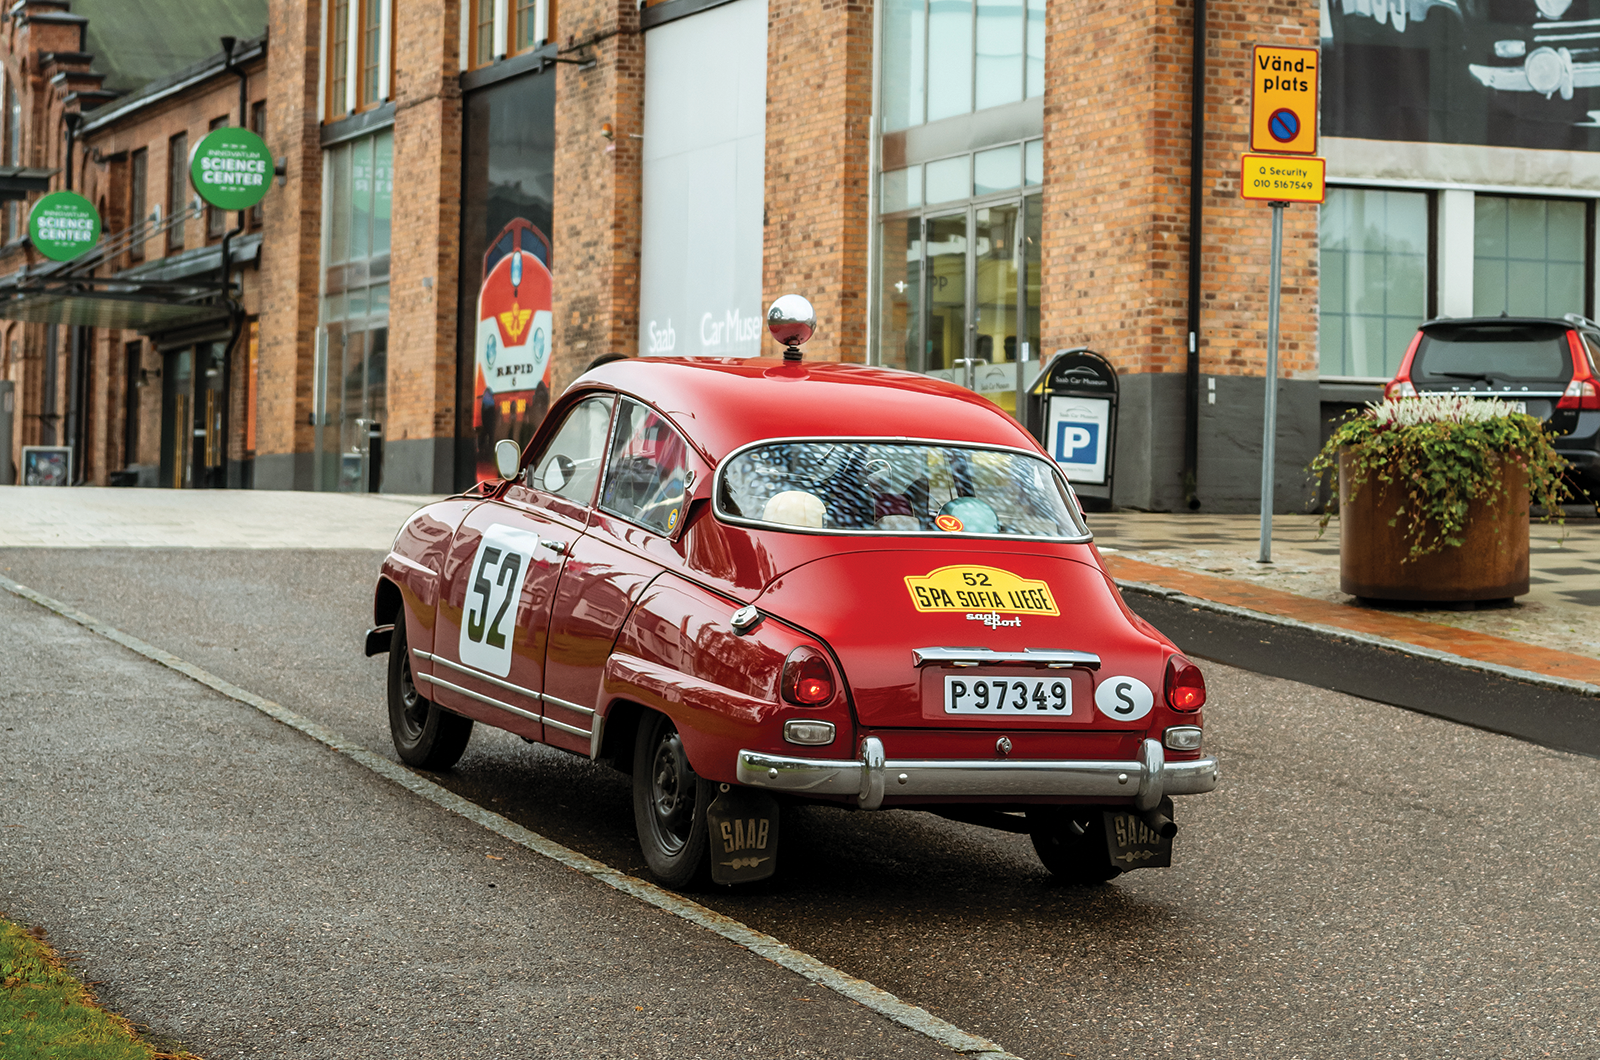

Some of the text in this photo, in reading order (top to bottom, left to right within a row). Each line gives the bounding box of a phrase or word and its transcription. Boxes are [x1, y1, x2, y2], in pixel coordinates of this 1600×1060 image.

[1258, 55, 1315, 73] Vänd-
[1264, 75, 1308, 93] plats
[201, 157, 266, 173] SCIENCE
[1259, 166, 1307, 178] Q Security
[202, 170, 263, 186] CENTER
[1253, 179, 1313, 190] 010 5167549
[37, 216, 94, 230] SCIENCE
[38, 228, 91, 242] CENTER
[648, 308, 763, 353] Saab Car Muse
[497, 363, 534, 377] RAPID
[1063, 426, 1091, 459] P
[962, 572, 992, 586] 52
[468, 546, 522, 650] 52
[915, 586, 1052, 611] SPA SOFIA LIEGE
[1114, 682, 1135, 715] S
[720, 818, 770, 853] SAAB
